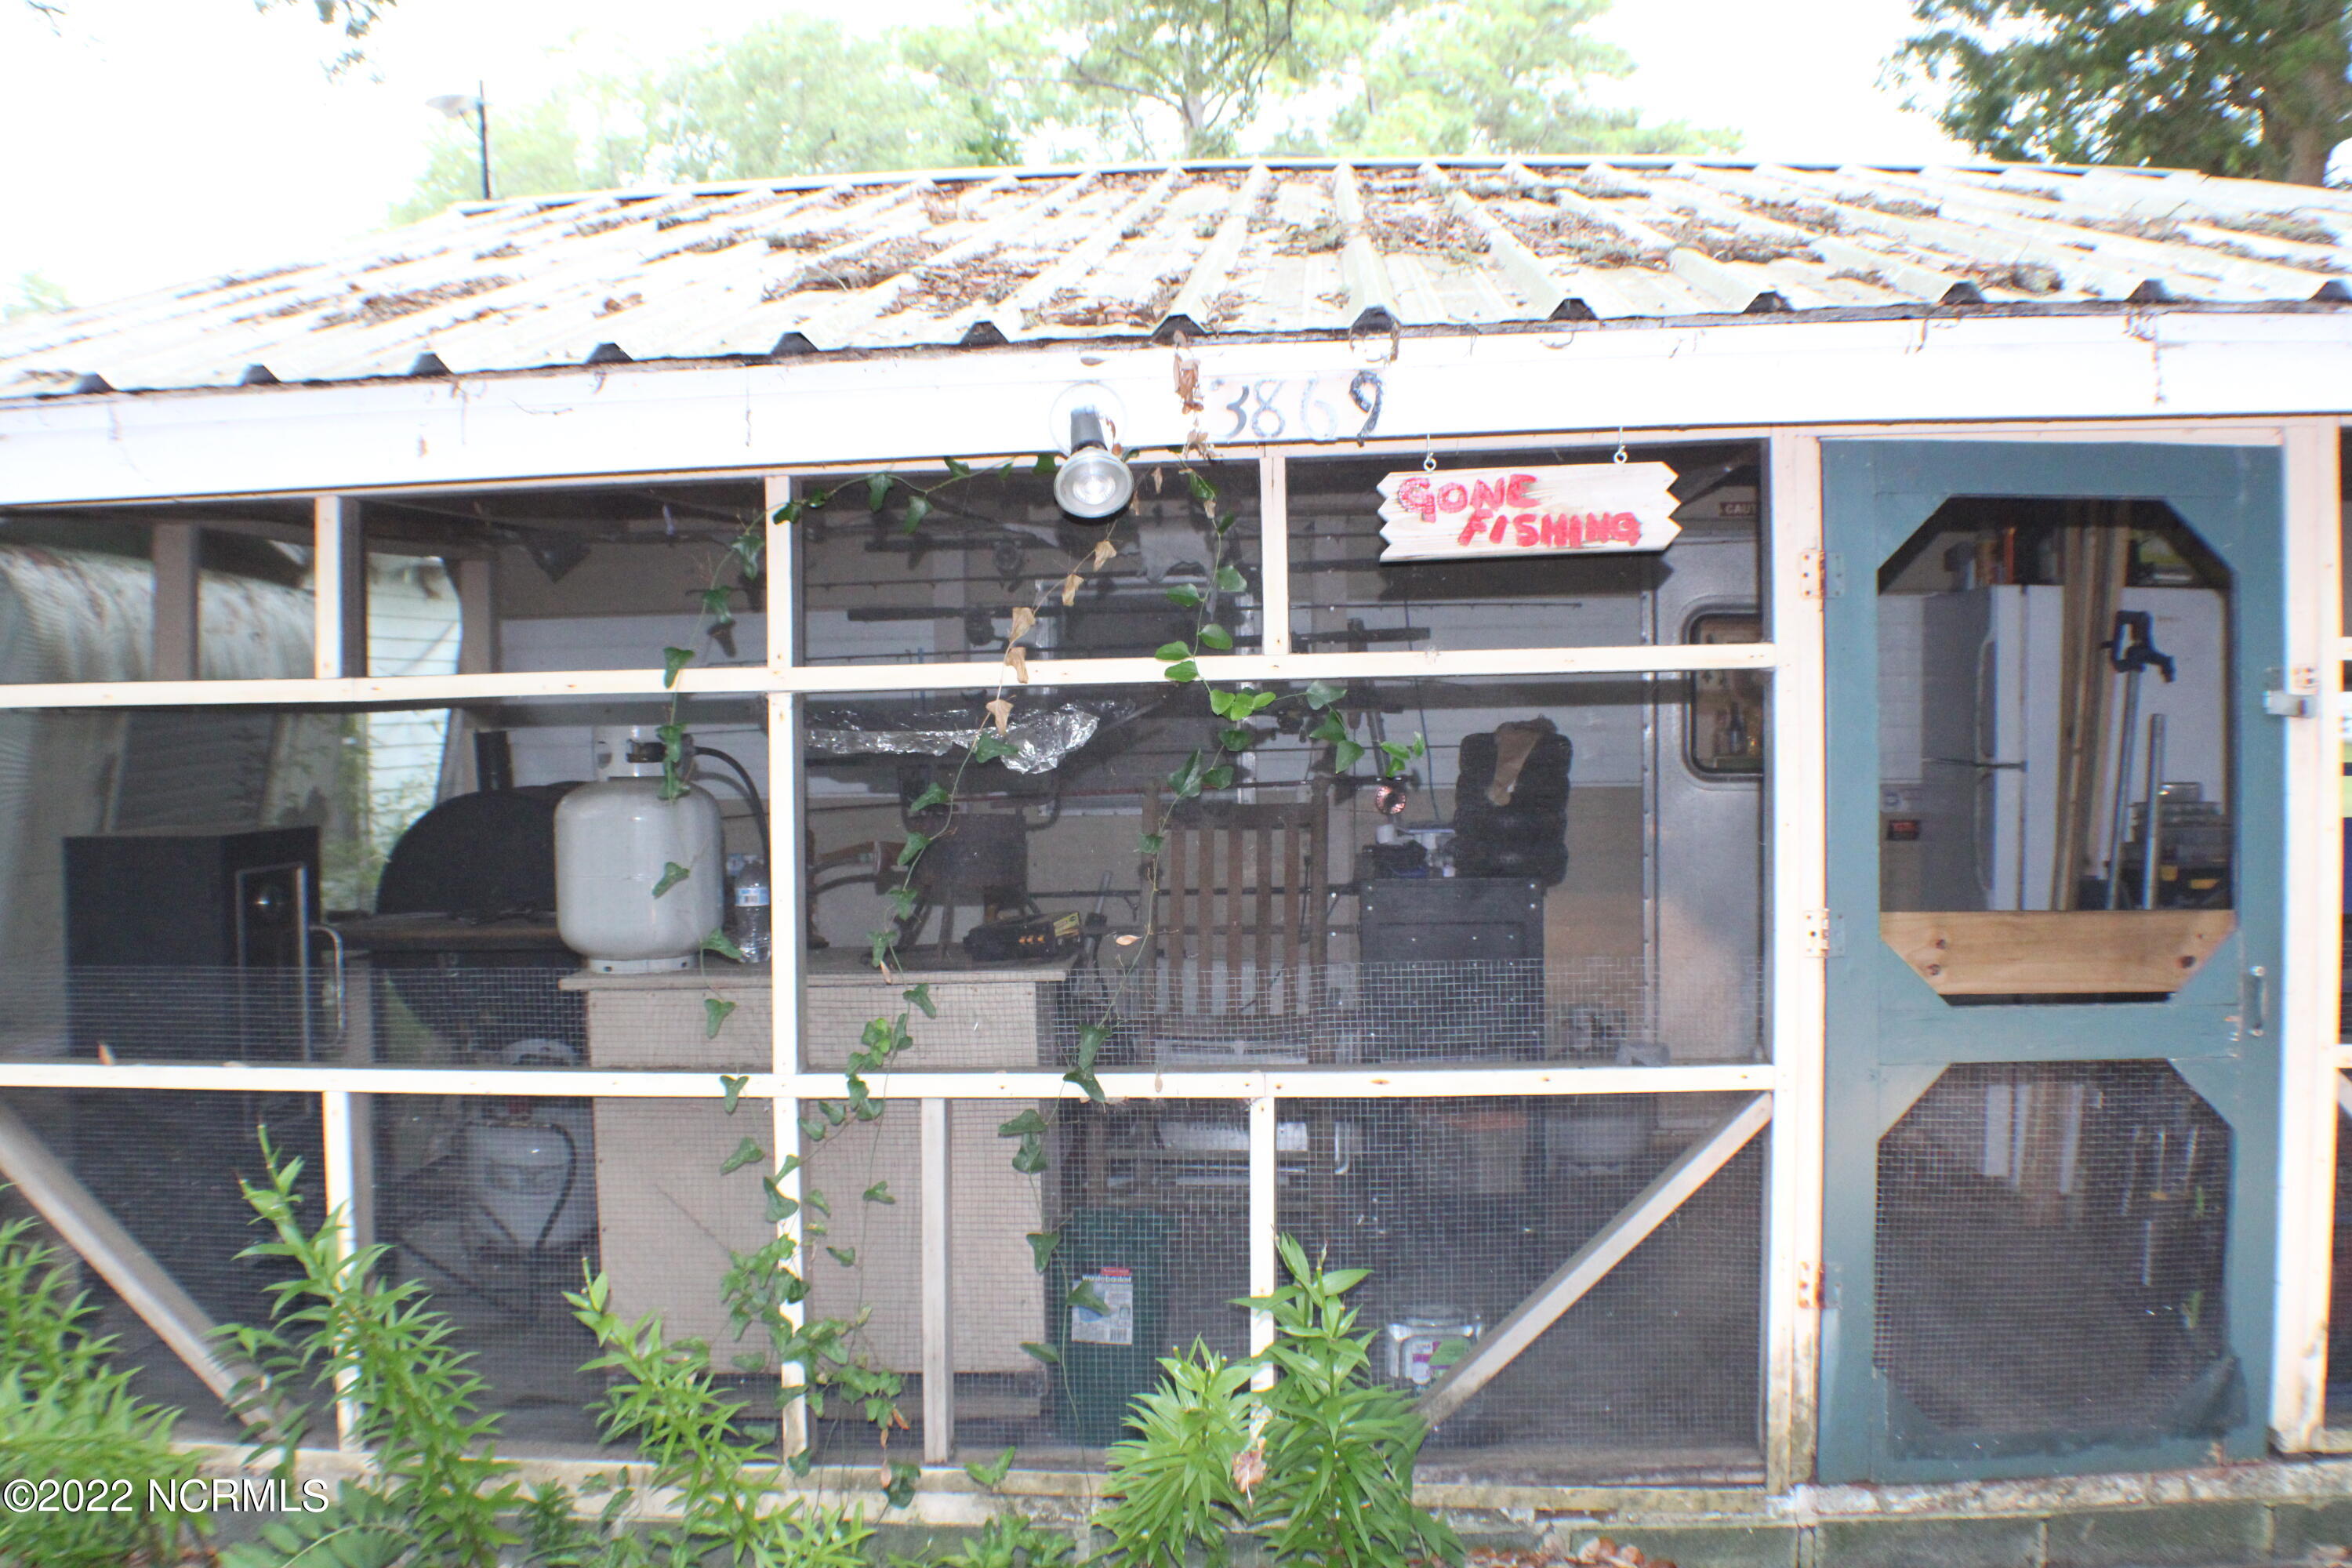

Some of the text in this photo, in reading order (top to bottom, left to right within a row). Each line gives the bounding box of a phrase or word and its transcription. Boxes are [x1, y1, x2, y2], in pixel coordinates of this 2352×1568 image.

[1209, 370, 1384, 447] 3869
[1398, 473, 1542, 524] GONE
[1457, 508, 1642, 548] FISHING
